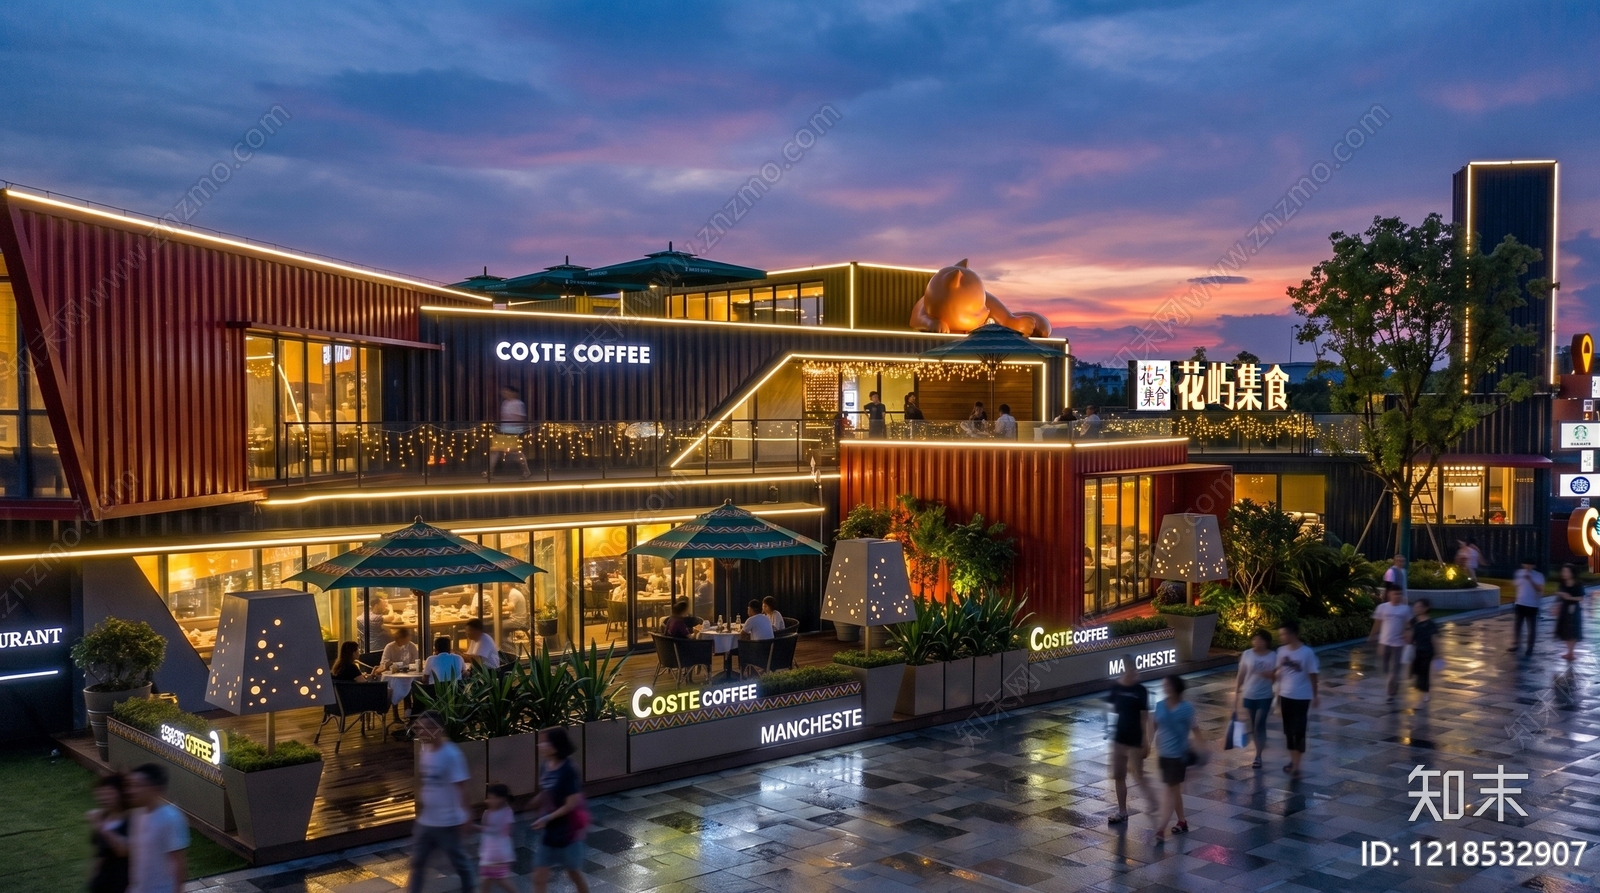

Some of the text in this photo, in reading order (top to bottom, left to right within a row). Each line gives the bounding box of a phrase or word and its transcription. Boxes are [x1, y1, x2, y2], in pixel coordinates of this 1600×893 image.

[496, 341, 650, 363] COSTE COFFEE
[1177, 361, 1289, 411] 花屿集食
[0, 628, 63, 648] URANT
[1073, 626, 1109, 644] COFFEE
[1109, 649, 1176, 675] MACHESTE
[702, 684, 757, 707] COFFEE
[761, 708, 863, 744] MANCHESTE
